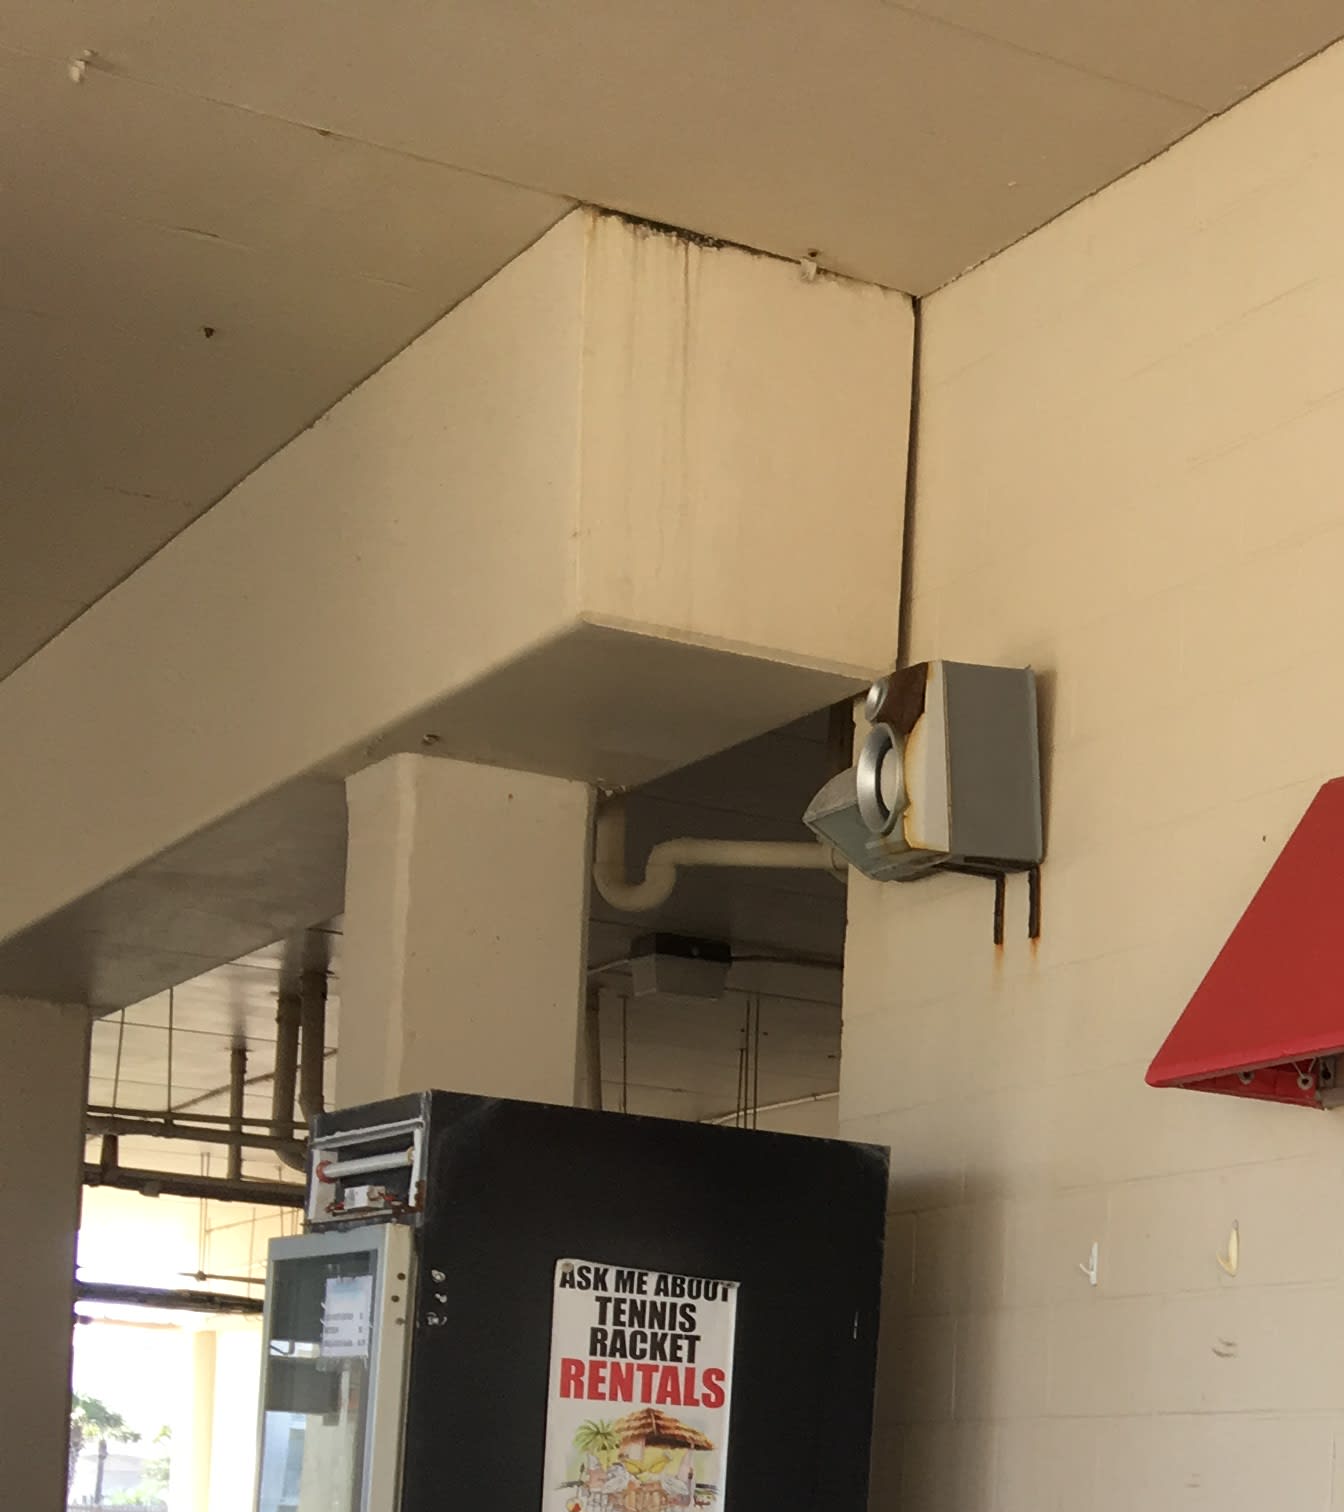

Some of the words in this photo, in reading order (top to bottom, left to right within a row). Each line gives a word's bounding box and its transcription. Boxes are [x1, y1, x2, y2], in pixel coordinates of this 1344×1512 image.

[560, 1265, 609, 1292] ASK
[615, 1269, 648, 1295] ME
[655, 1274, 731, 1302] ABOUT
[595, 1296, 697, 1333] TENNIS
[589, 1327, 701, 1364] RACKET
[559, 1358, 726, 1409] RENTALS
